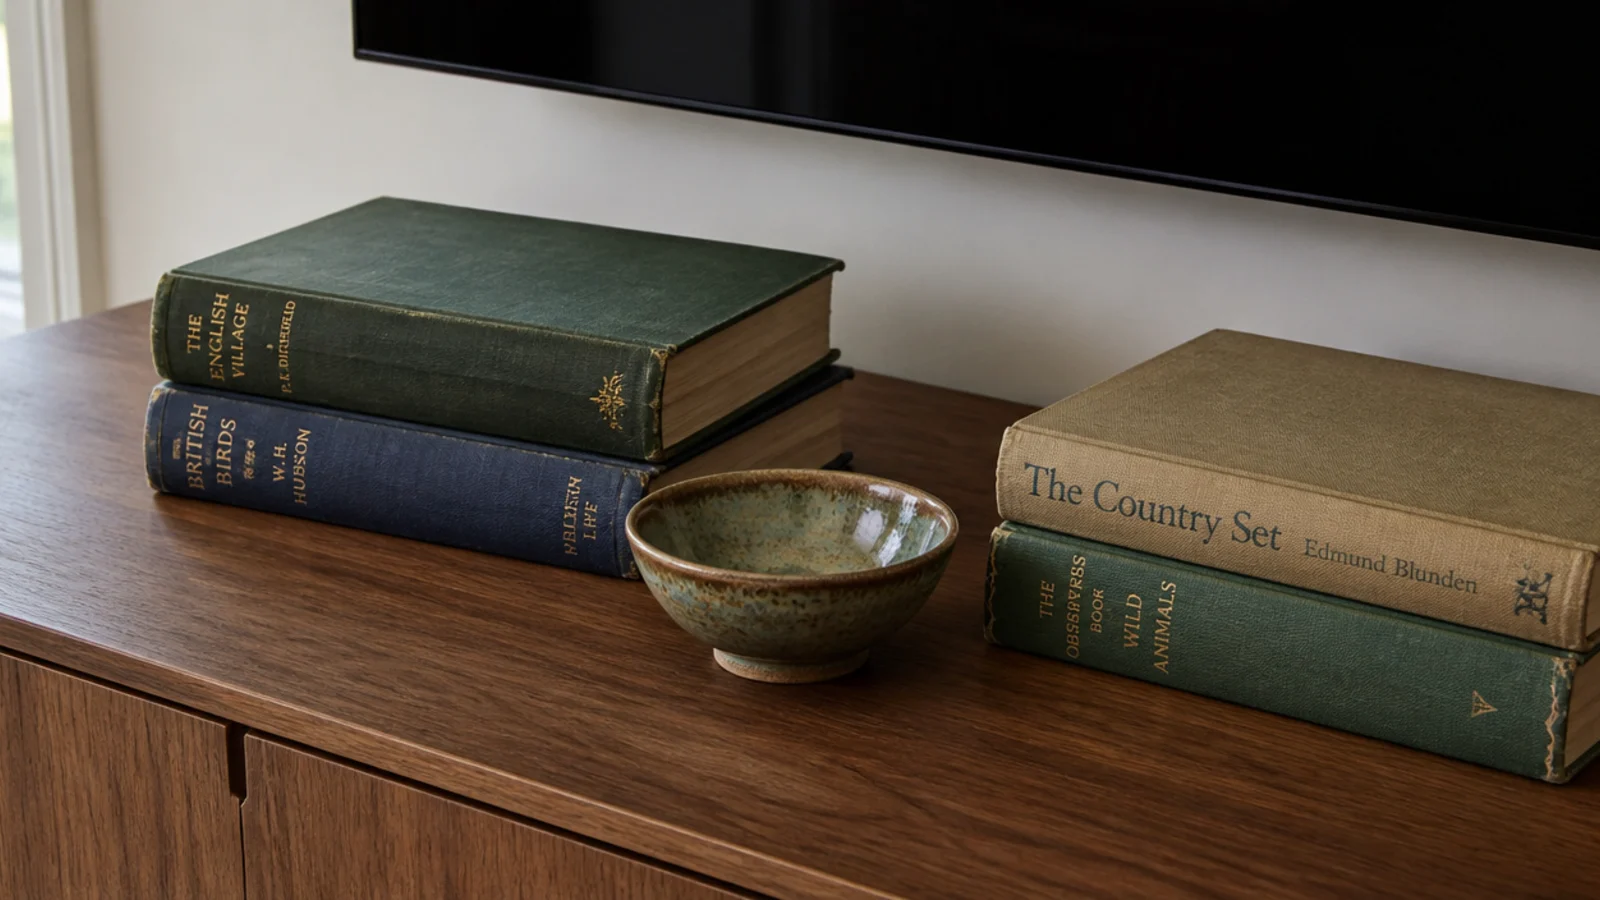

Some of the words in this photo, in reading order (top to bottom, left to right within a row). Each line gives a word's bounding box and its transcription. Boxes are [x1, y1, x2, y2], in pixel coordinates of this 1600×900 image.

[187, 314, 203, 354] THE
[208, 293, 231, 381] ENGLISH
[231, 302, 250, 378] VILLAGE
[185, 403, 209, 490] BRITISH
[215, 418, 237, 487] BIRDS
[1024, 462, 1083, 505] The
[1093, 480, 1222, 545] Country
[1231, 510, 1282, 551] Set
[1039, 580, 1055, 618] THE
[1304, 538, 1388, 574] Edmund
[1394, 557, 1479, 594] Blunden
[1123, 593, 1143, 649] WILD
[1154, 580, 1177, 676] ANIMALS
